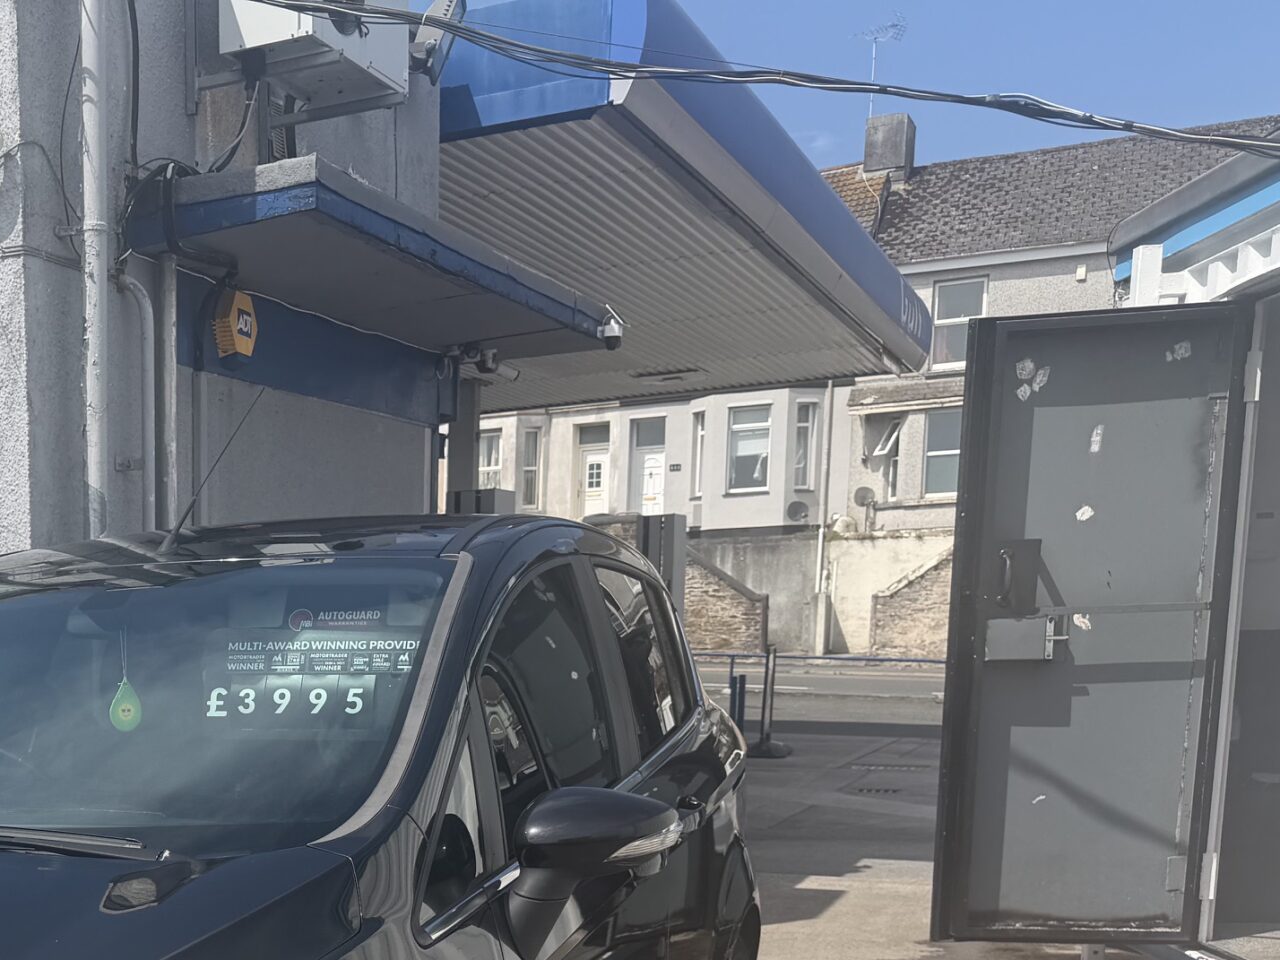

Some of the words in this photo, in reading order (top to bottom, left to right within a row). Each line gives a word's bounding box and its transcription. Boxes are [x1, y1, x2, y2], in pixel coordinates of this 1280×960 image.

[237, 313, 252, 335] ADT
[318, 610, 381, 620] AUTOGUARD
[228, 641, 310, 651] MULTI-AWARD
[311, 640, 367, 650] WINNING
[227, 662, 265, 670] WINNER
